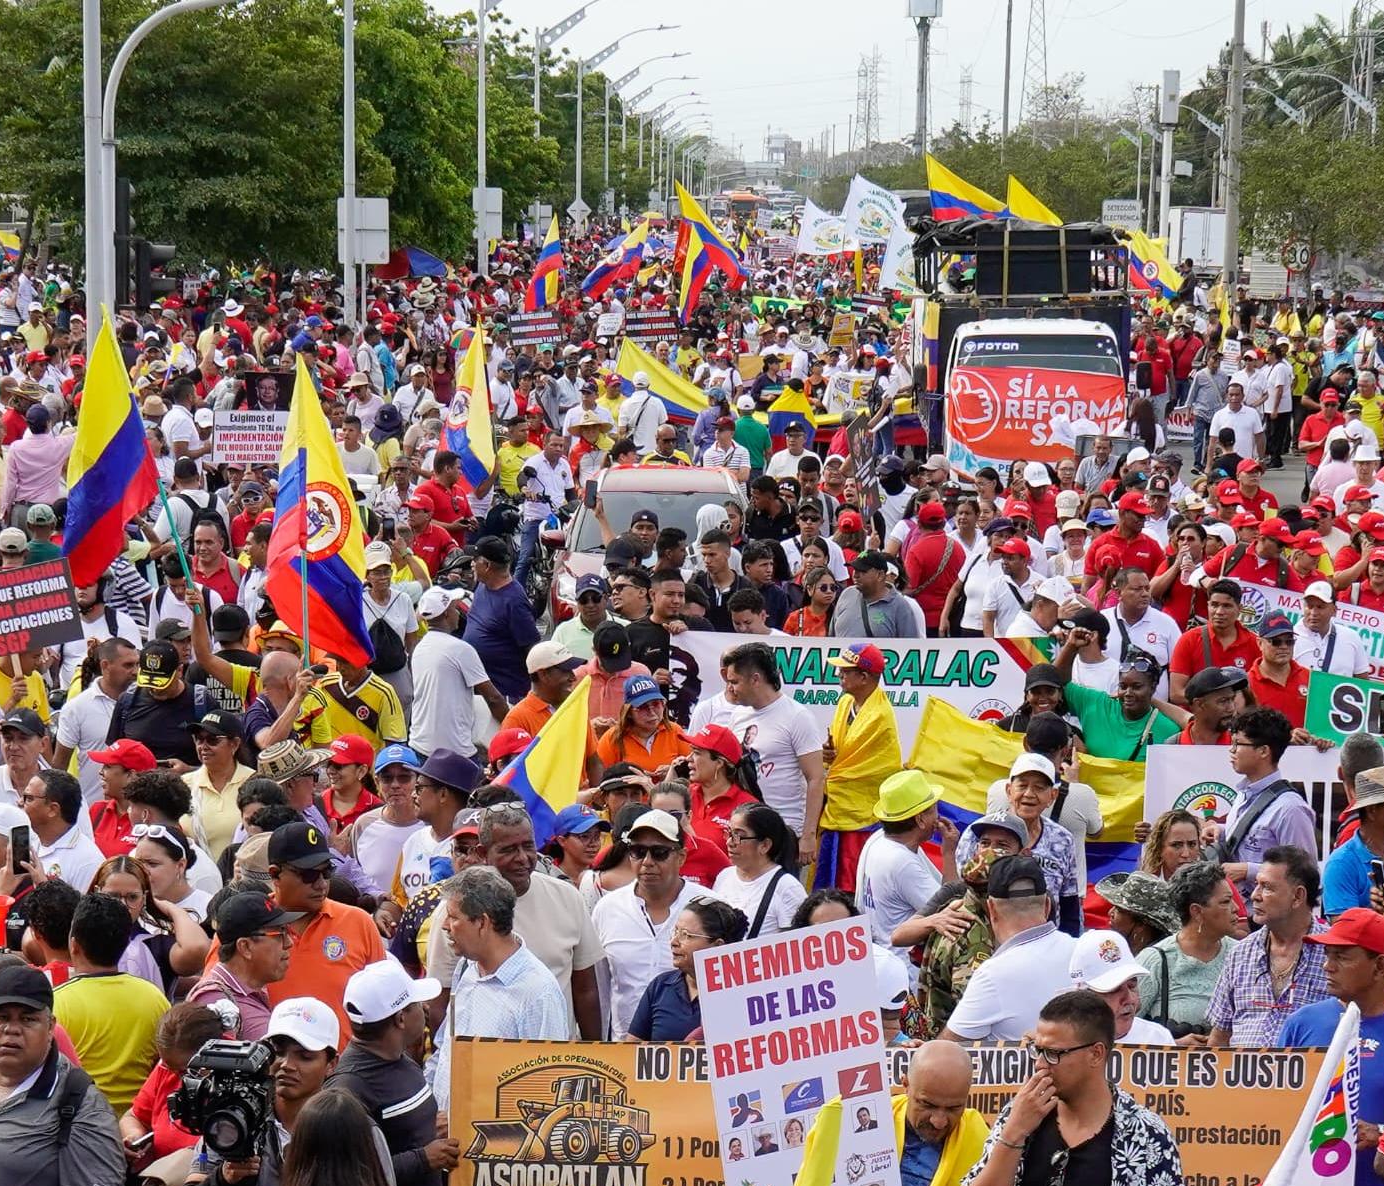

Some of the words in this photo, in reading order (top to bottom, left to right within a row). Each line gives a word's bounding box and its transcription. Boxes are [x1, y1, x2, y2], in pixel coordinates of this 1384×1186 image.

[1008, 373, 1032, 399] SÍ
[1035, 385, 1048, 399] A
[1056, 385, 1080, 399] LA
[230, 412, 266, 423] Exigimos
[267, 412, 275, 422] el
[1004, 398, 1126, 421] REFORMA
[1004, 421, 1012, 429] A
[1014, 421, 1029, 430] LA
[15, 575, 68, 600] REFORMA
[15, 592, 72, 616] GENERAL
[704, 926, 867, 992] ENEMIGOS
[746, 992, 782, 1027] DE
[787, 979, 836, 1017] LAS
[713, 1011, 880, 1078] REFORMAS
[551, 1054, 563, 1063] DE
[636, 1046, 670, 1080] NO
[1132, 1050, 1183, 1088] QUE
[1187, 1052, 1217, 1087] ES
[1225, 1053, 1304, 1089] JUSTO
[1145, 1091, 1190, 1117] PAÍS.
[1176, 1123, 1281, 1151] prestación
